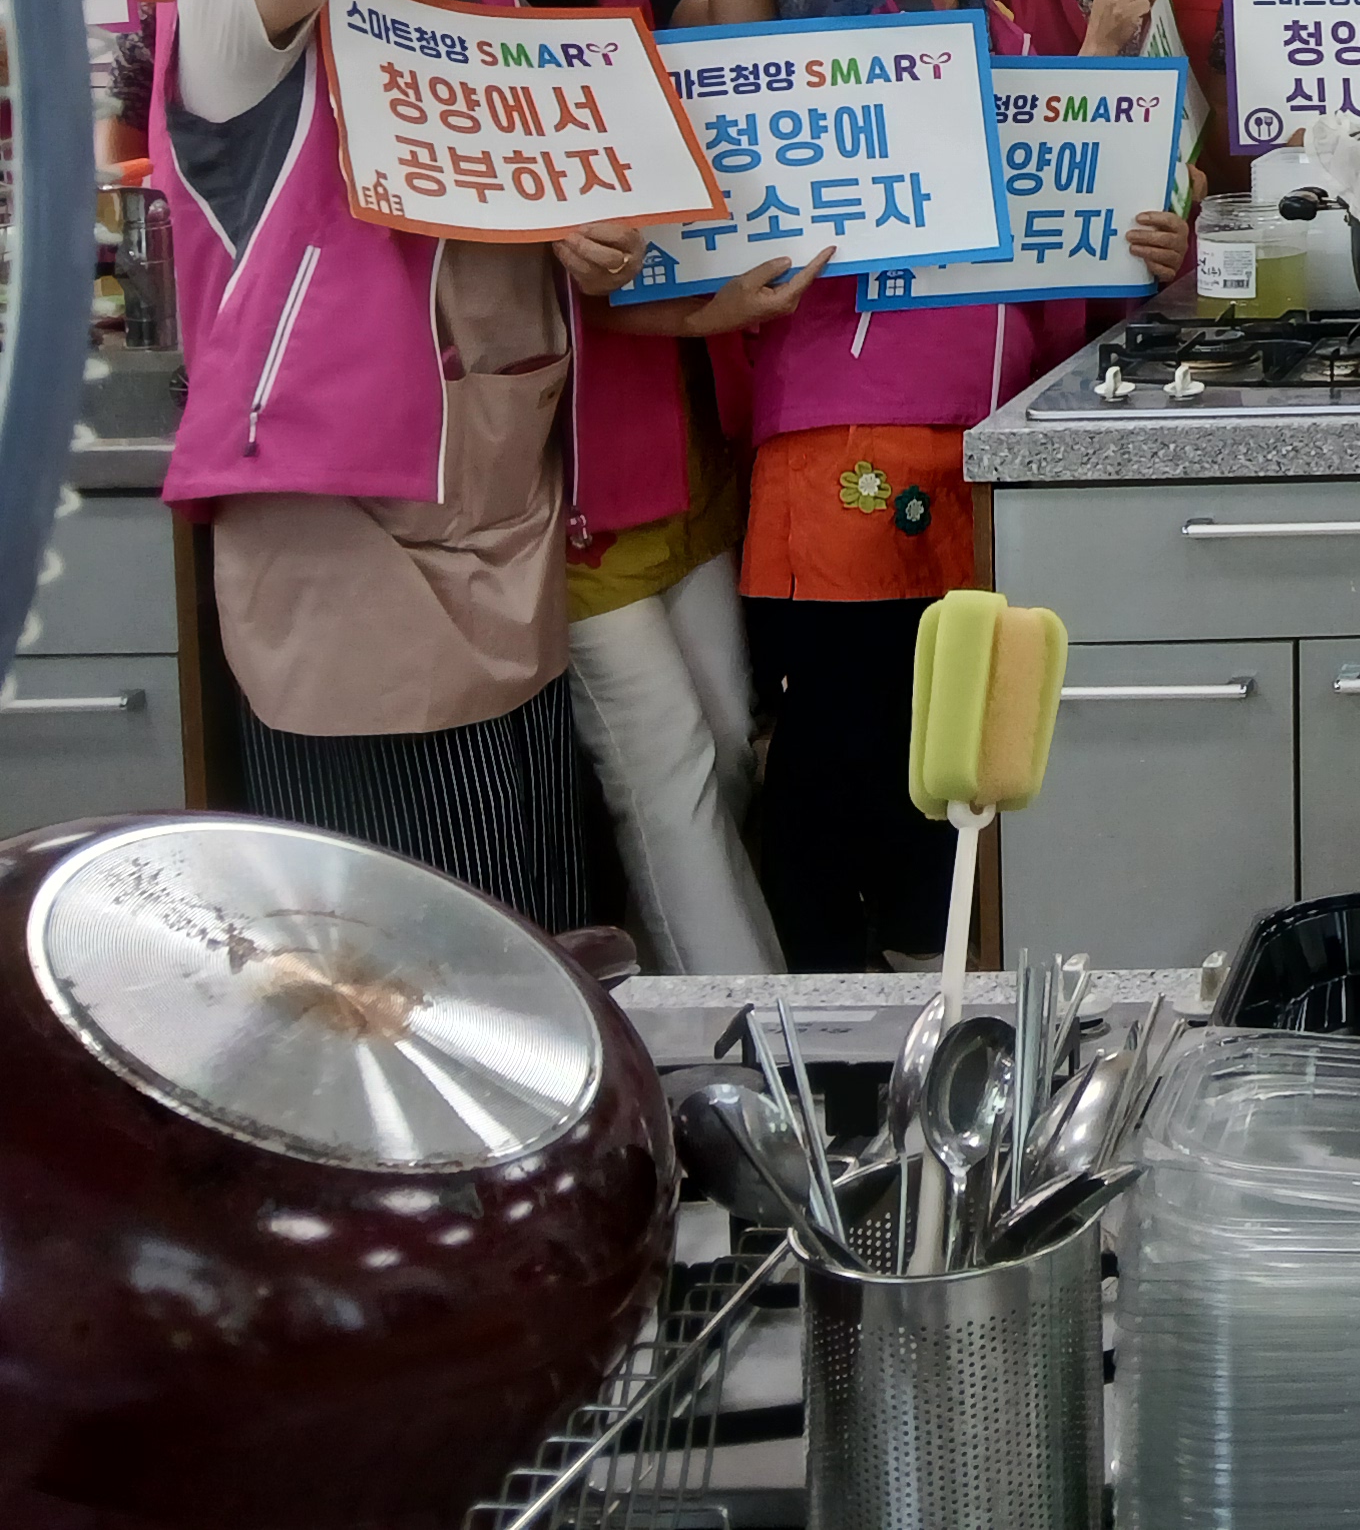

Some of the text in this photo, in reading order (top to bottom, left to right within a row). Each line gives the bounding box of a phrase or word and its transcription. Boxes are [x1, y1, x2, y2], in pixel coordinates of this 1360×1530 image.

[346, 0, 469, 65] 스마트청양
[379, 61, 609, 137] 청양에서
[668, 60, 796, 100] 마트청양
[397, 134, 633, 205] 공부하자
[705, 104, 890, 173] 청양에
[1006, 141, 1100, 196] 양에
